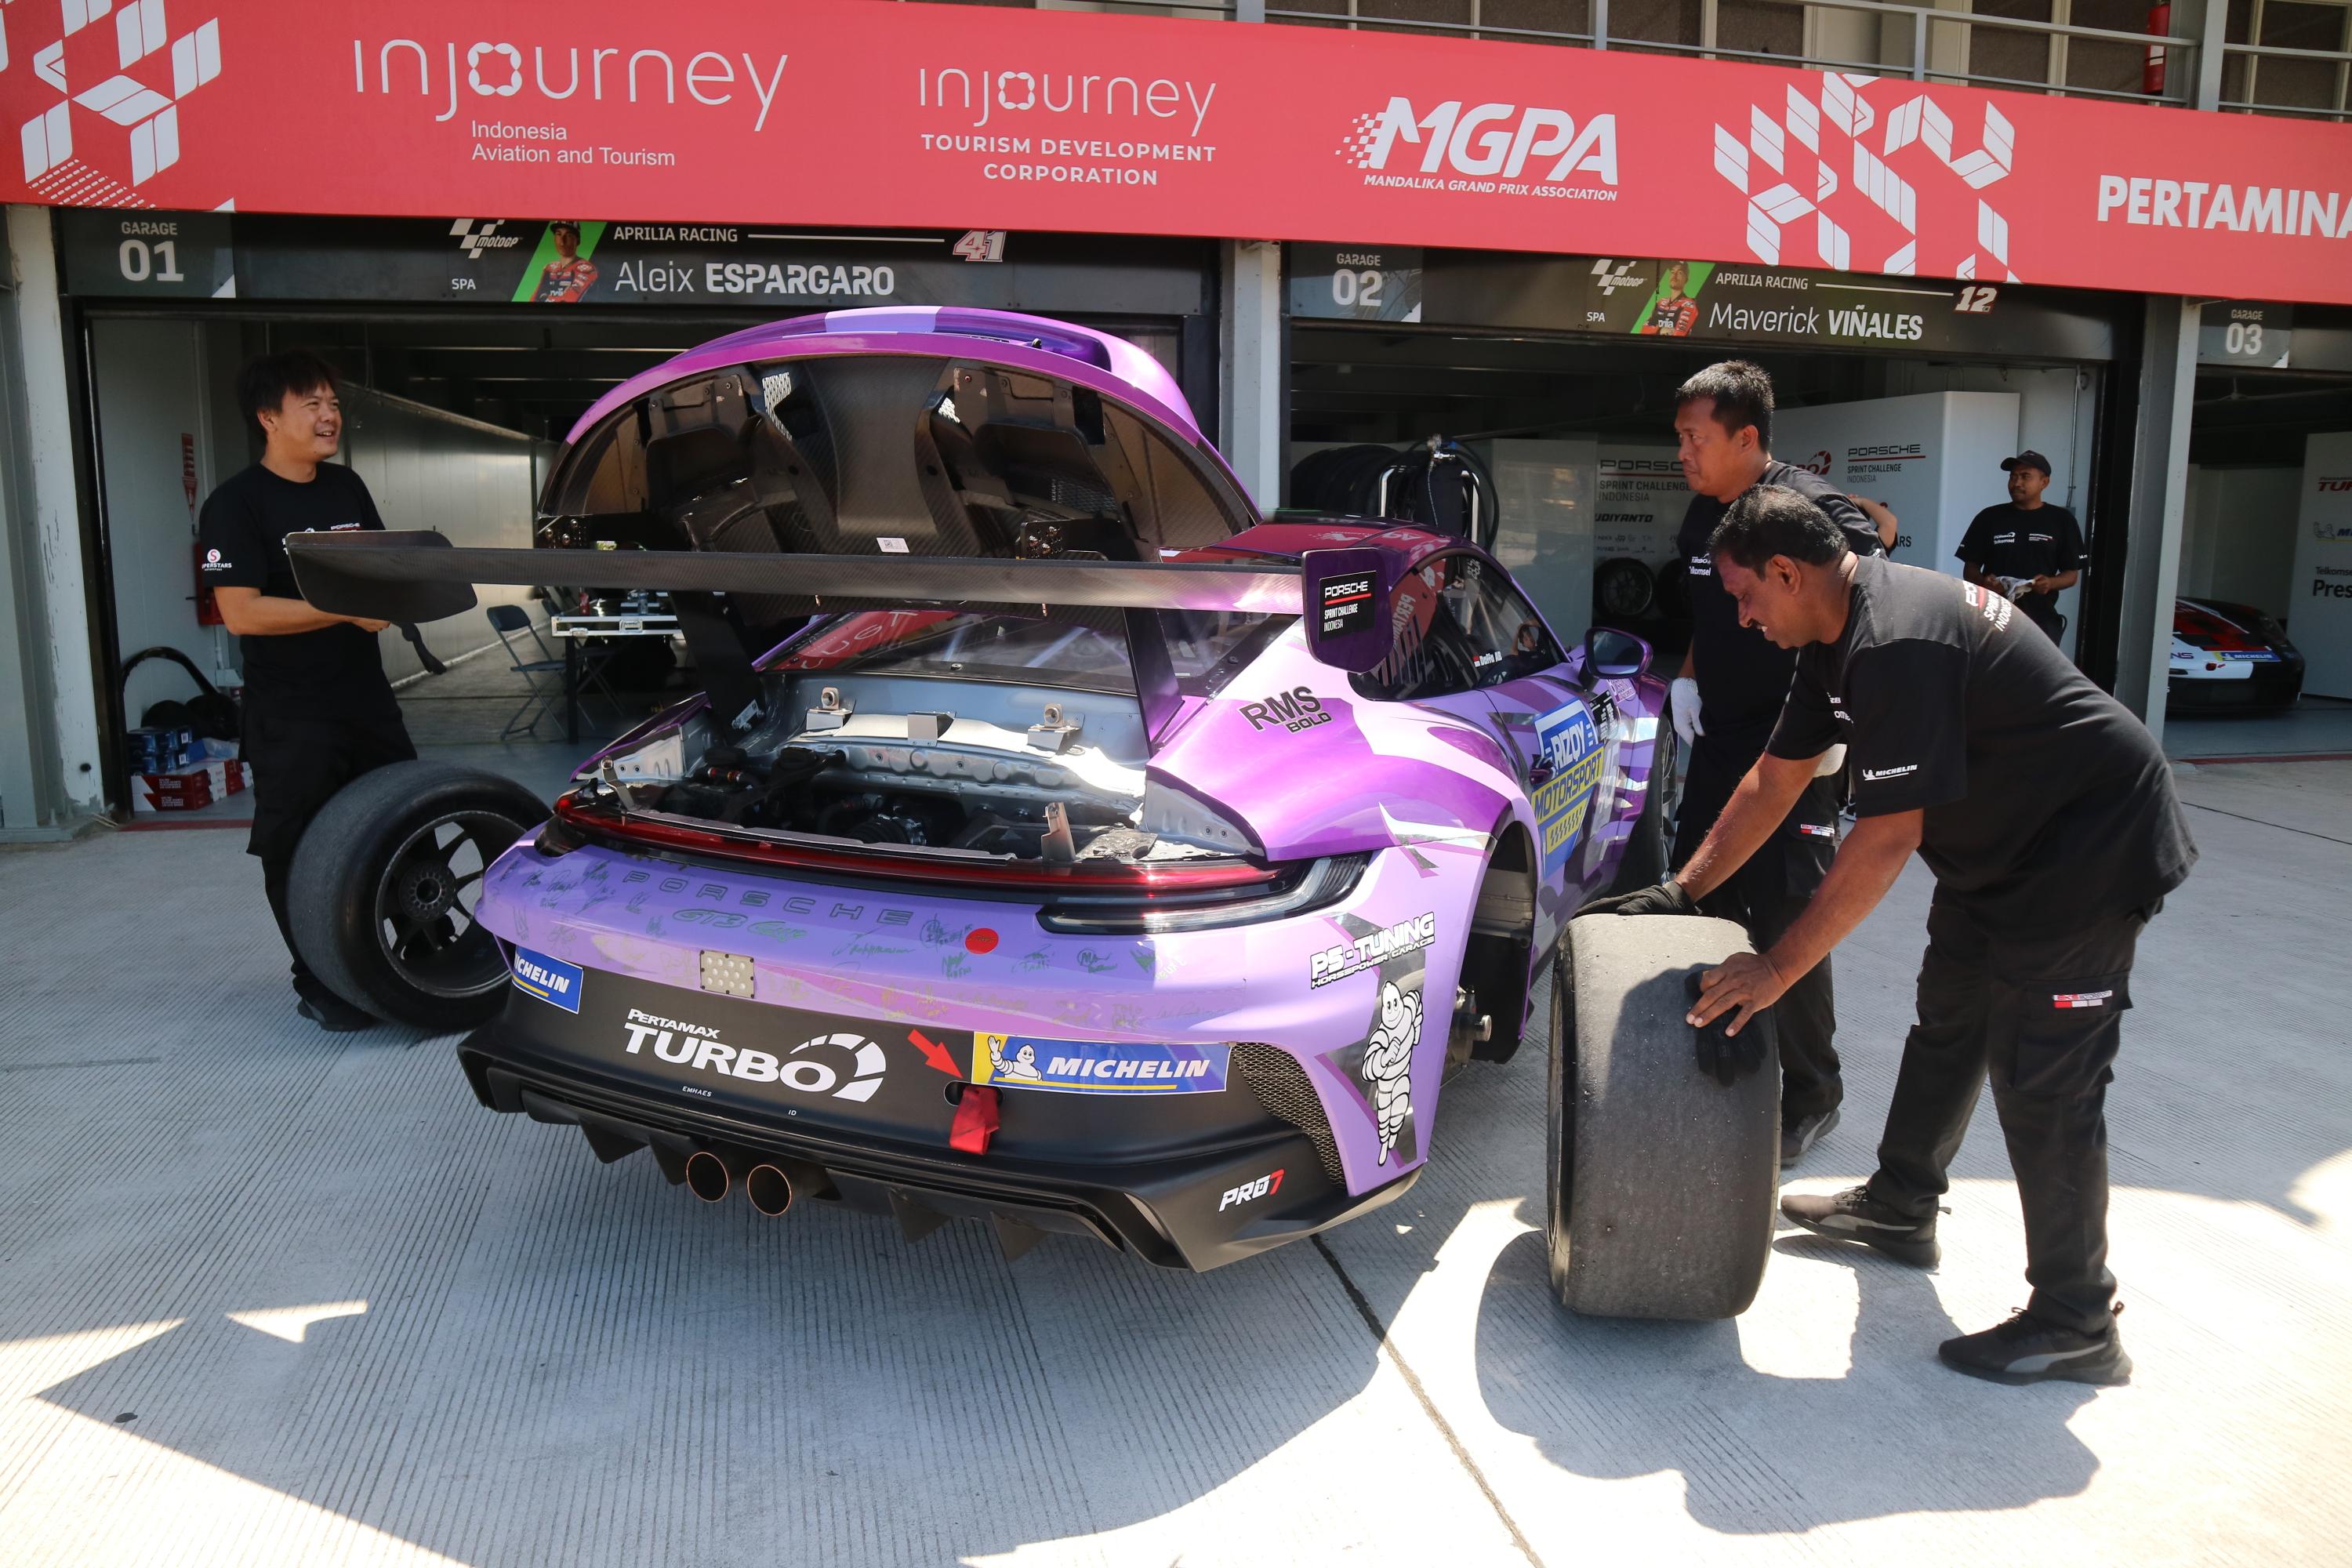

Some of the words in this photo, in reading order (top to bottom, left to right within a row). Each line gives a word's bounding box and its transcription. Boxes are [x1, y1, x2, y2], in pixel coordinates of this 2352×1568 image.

[471, 120, 568, 141] Indonesia
[1367, 96, 1619, 186] MGPA
[472, 142, 550, 163] Aviation
[557, 147, 593, 164] and
[599, 147, 676, 166] Tourism
[921, 133, 1031, 154] TOURISM
[1041, 137, 1217, 162] DEVELOPMENT
[983, 163, 1158, 185] CORPORATION
[1363, 174, 1446, 191] MANDALIKA
[1448, 179, 1496, 194] GRAND
[1498, 182, 1530, 196] PRIX
[1531, 184, 1618, 201] ASSOCIATION
[121, 221, 178, 236] GARAGE
[614, 226, 677, 241] APRILIA
[680, 227, 739, 242] RACING
[952, 229, 1007, 263] 41
[118, 239, 184, 282] 01
[1336, 252, 1381, 267] GARAGE
[452, 278, 476, 290] SPA
[615, 260, 695, 292] Aleix
[706, 262, 895, 296] ESPARGARO
[1332, 268, 1383, 307] 02
[1715, 272, 1762, 287] APRILIA
[1766, 275, 1809, 291] RACING
[1954, 285, 1998, 314] 12
[1586, 311, 1606, 322] SPA
[1708, 302, 1820, 335] Maverick
[1828, 304, 1923, 341] VIÑALES
[2231, 309, 2263, 321] GARAGE
[2225, 323, 2263, 355] 03
[1848, 444, 1921, 457] PORSCHE
[1600, 459, 1684, 471] PORSC
[1847, 464, 1867, 474] SPRINT
[1867, 463, 1902, 473] CHALLENGE
[1599, 480, 1635, 490] SPRINT
[1846, 474, 1876, 484] INDONESIA
[1599, 492, 1650, 503] INDONESIA
[1324, 580, 1369, 599] PORSCHE
[2313, 579, 2352, 598] Pres
[1324, 607, 1338, 620] SPRINT
[1338, 603, 1359, 617] CHALLENGE
[1323, 618, 1344, 633] INDONESIA
[1239, 685, 1322, 732] RMS
[1286, 712, 1334, 734] BOLD
[1550, 720, 1587, 771] RIZQY
[1875, 764, 1918, 777] MICHELIN
[1534, 753, 1603, 822] MOTORSPORT
[623, 869, 914, 927] PORSCHE
[672, 909, 749, 928] GT3
[1311, 952, 1390, 989] HORSEPOWER
[1391, 935, 1436, 960] GARAGE
[627, 1007, 721, 1040] PERTAMAX
[624, 1022, 837, 1093] TURBO
[1046, 1057, 1211, 1080] MICHELIN
[682, 1085, 713, 1098] EMHAES
